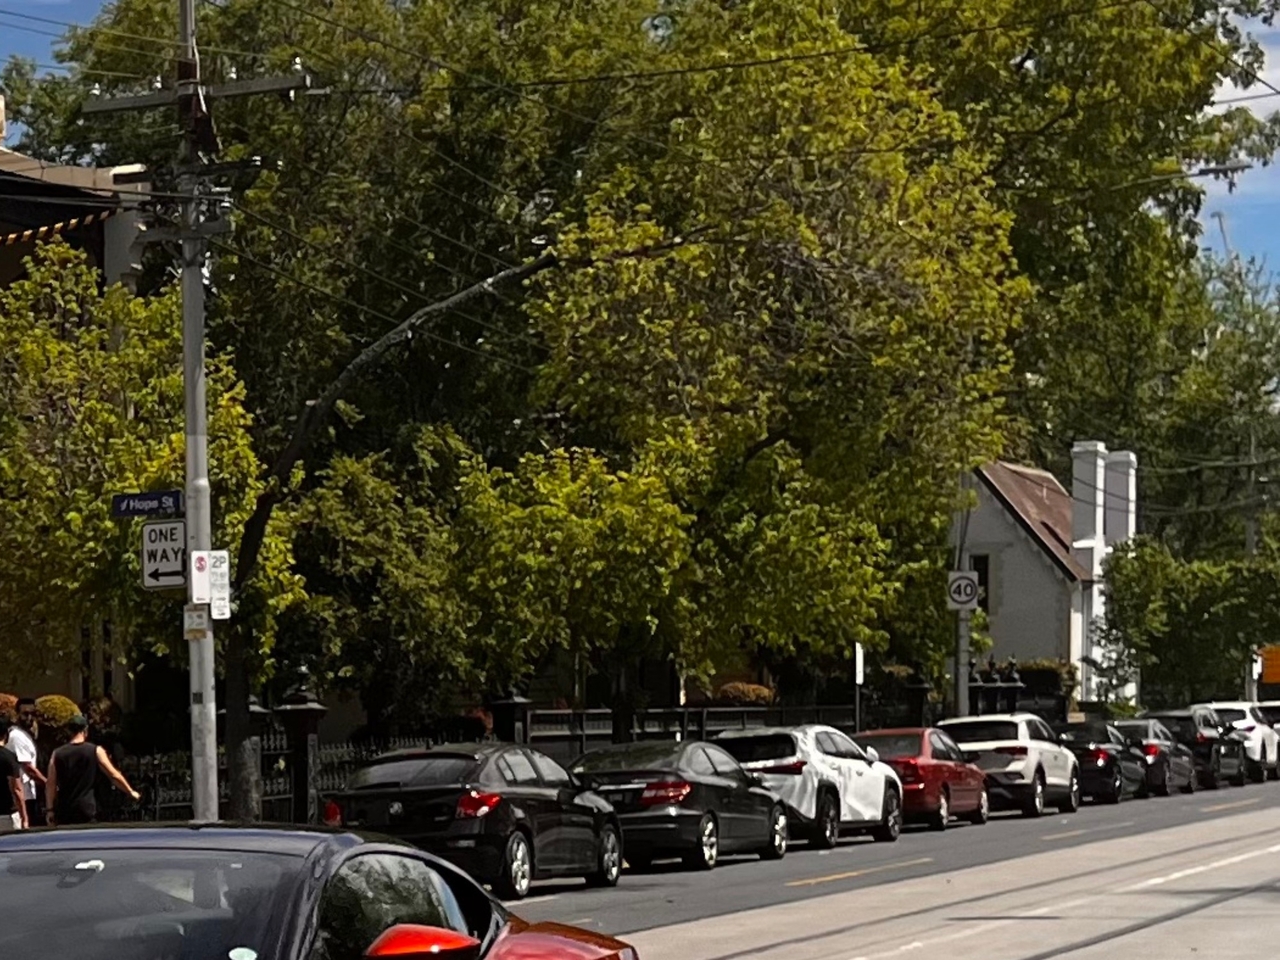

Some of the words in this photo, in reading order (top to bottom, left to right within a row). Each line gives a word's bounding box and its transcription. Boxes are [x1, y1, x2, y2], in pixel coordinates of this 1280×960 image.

[148, 527, 178, 543] ONE
[147, 547, 181, 563] WAY
[211, 556, 227, 568] 2P
[953, 583, 973, 597] 40
